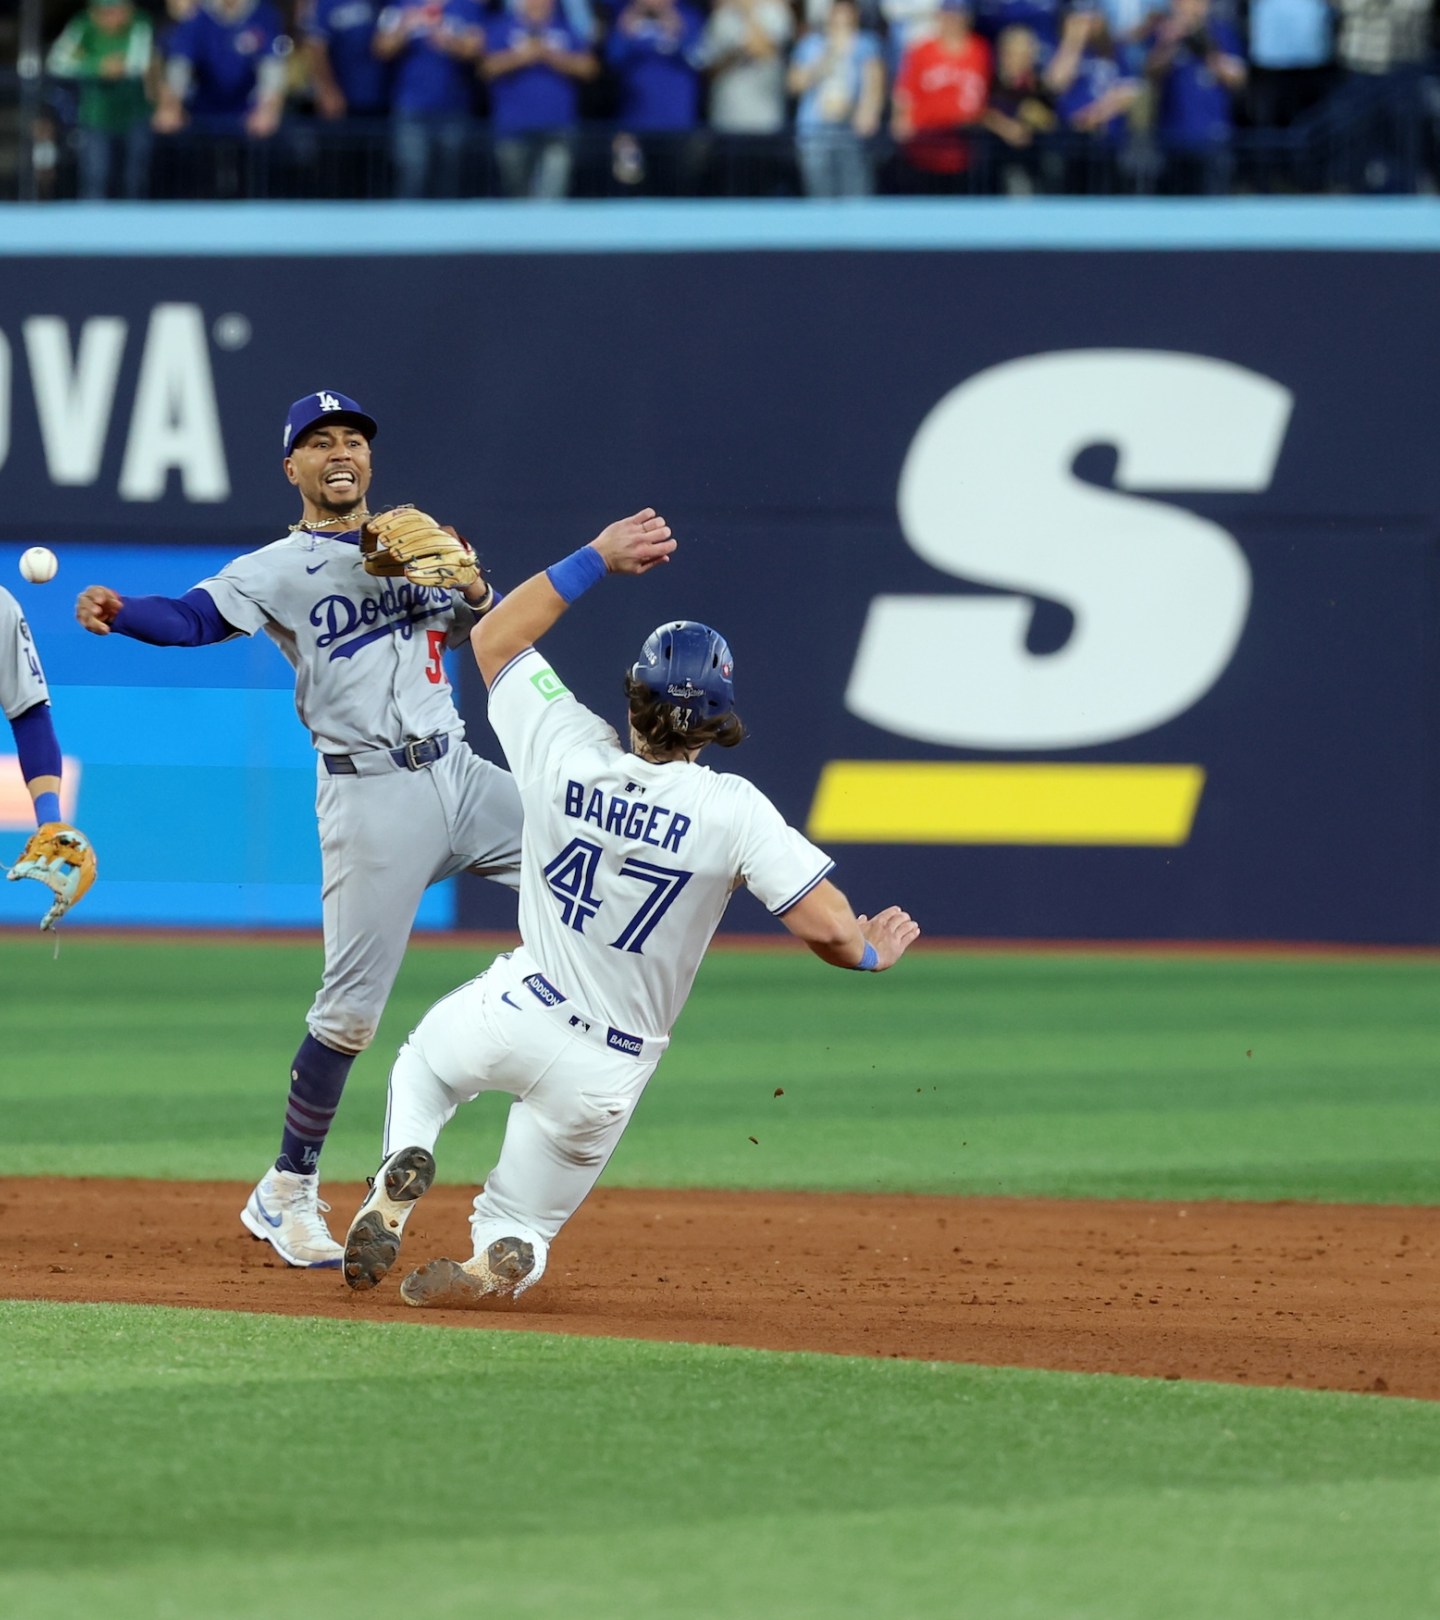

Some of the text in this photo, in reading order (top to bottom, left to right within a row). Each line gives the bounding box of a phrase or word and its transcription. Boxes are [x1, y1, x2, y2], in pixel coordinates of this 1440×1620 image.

[316, 391, 342, 411] LA
[844, 347, 1295, 751] S
[425, 629, 449, 685] 5
[565, 780, 691, 853] BARGER
[544, 837, 693, 954] 47
[527, 975, 560, 1006] ADDISON
